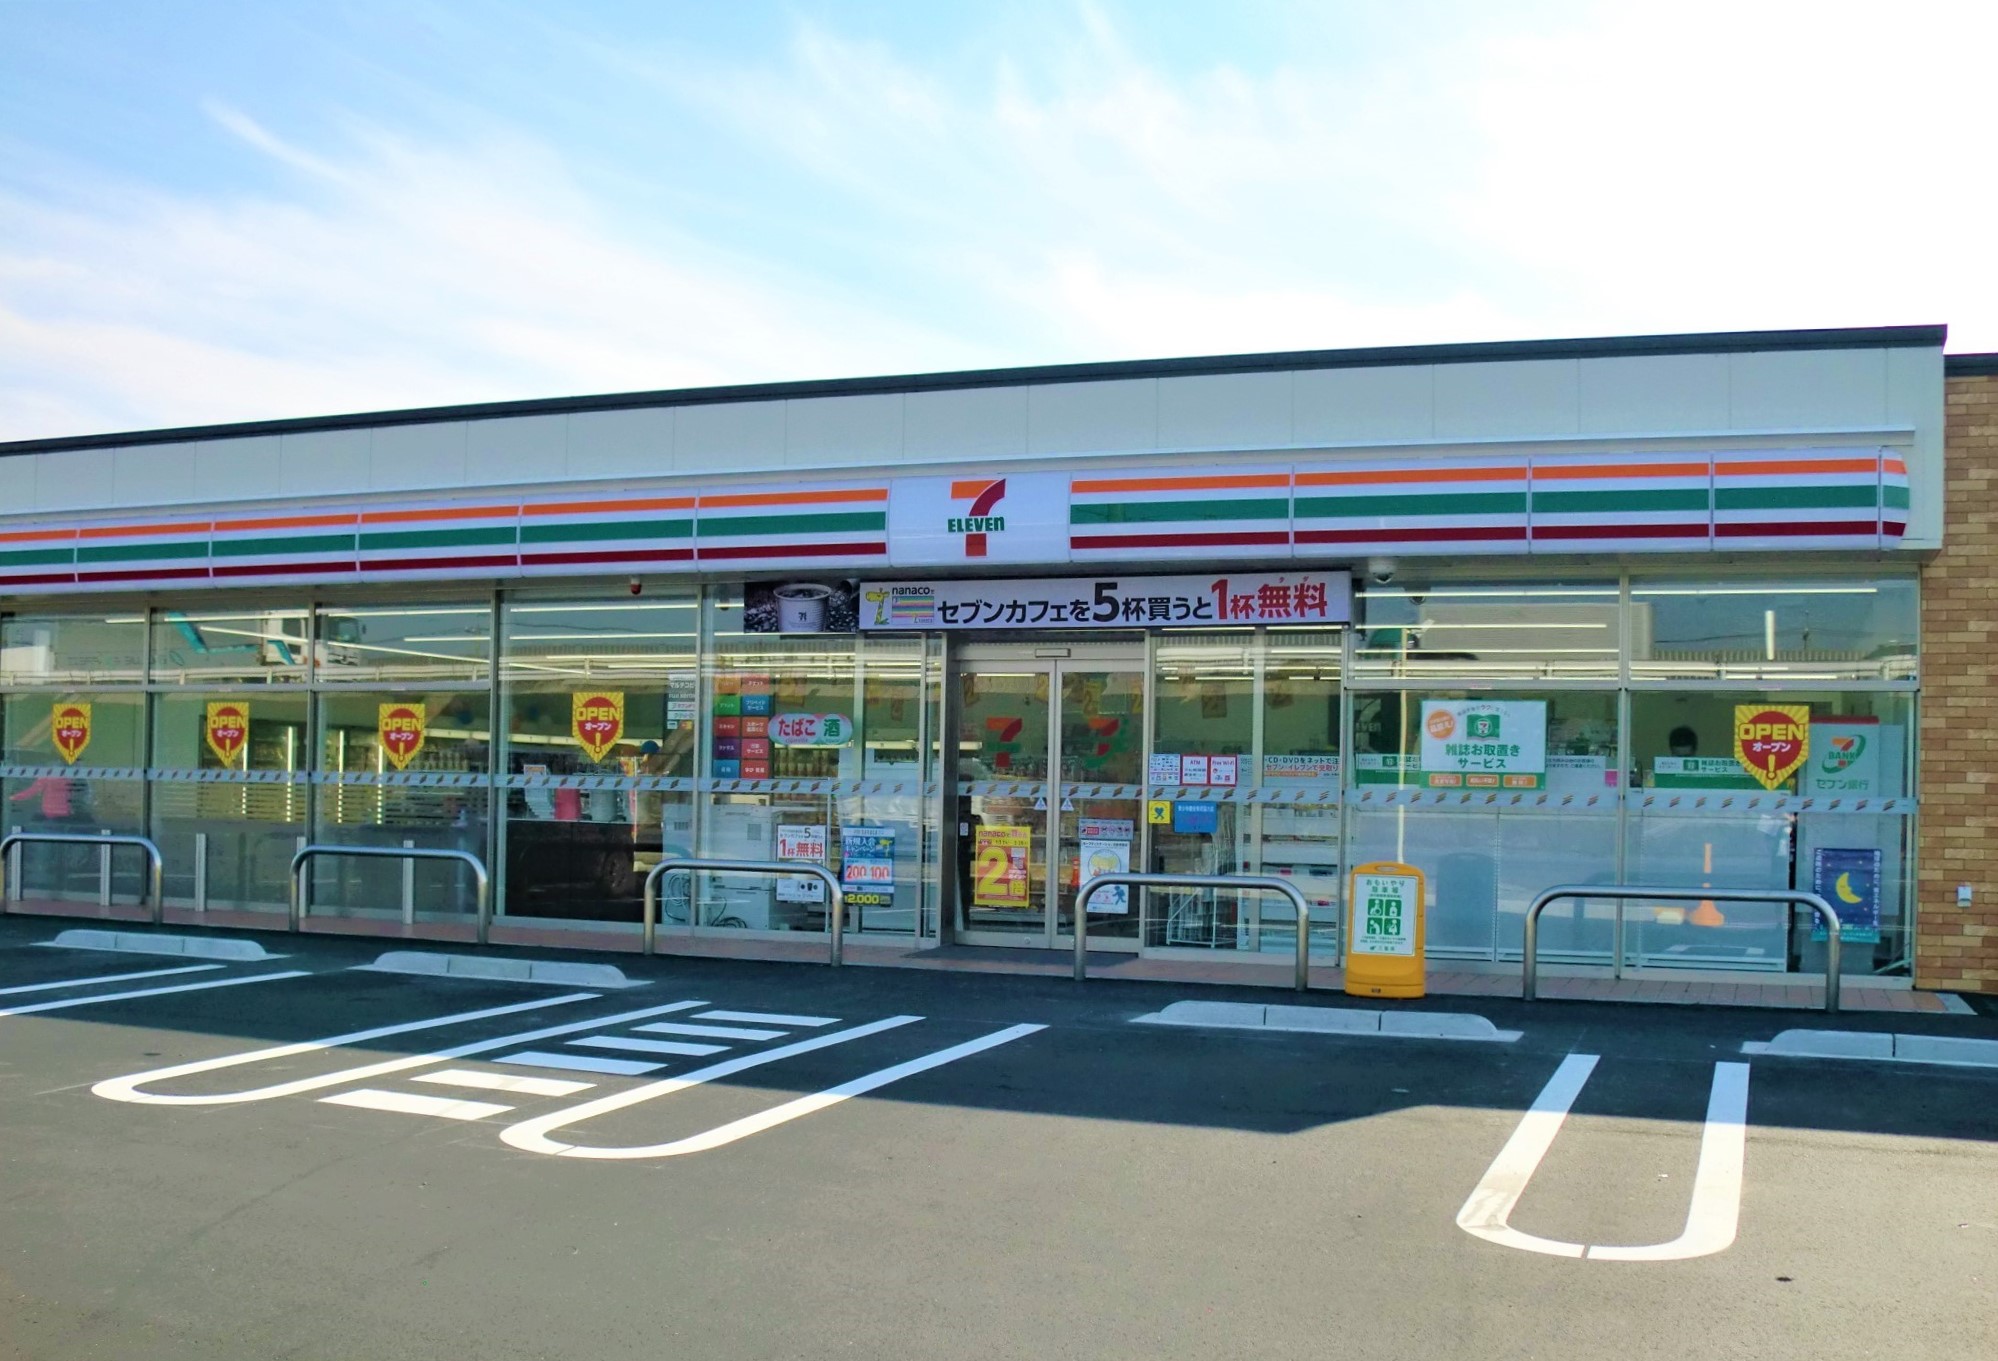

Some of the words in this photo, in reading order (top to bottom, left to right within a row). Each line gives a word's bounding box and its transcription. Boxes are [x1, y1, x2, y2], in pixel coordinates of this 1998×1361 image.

[950, 478, 1007, 557] 7
[576, 706, 620, 721] OPEN
[56, 716, 88, 729] OPEN
[210, 715, 248, 729] OPEN
[382, 717, 422, 731] OPEN
[584, 721, 612, 731] オープン
[778, 718, 816, 737] たばこ
[823, 718, 841, 737] 酒
[1739, 723, 1805, 741] OPEN
[1444, 743, 1521, 757] 雑誌お取置き
[1752, 742, 1791, 753] オープン
[1457, 757, 1507, 769] サービス
[1816, 778, 1870, 791] セブン銀行
